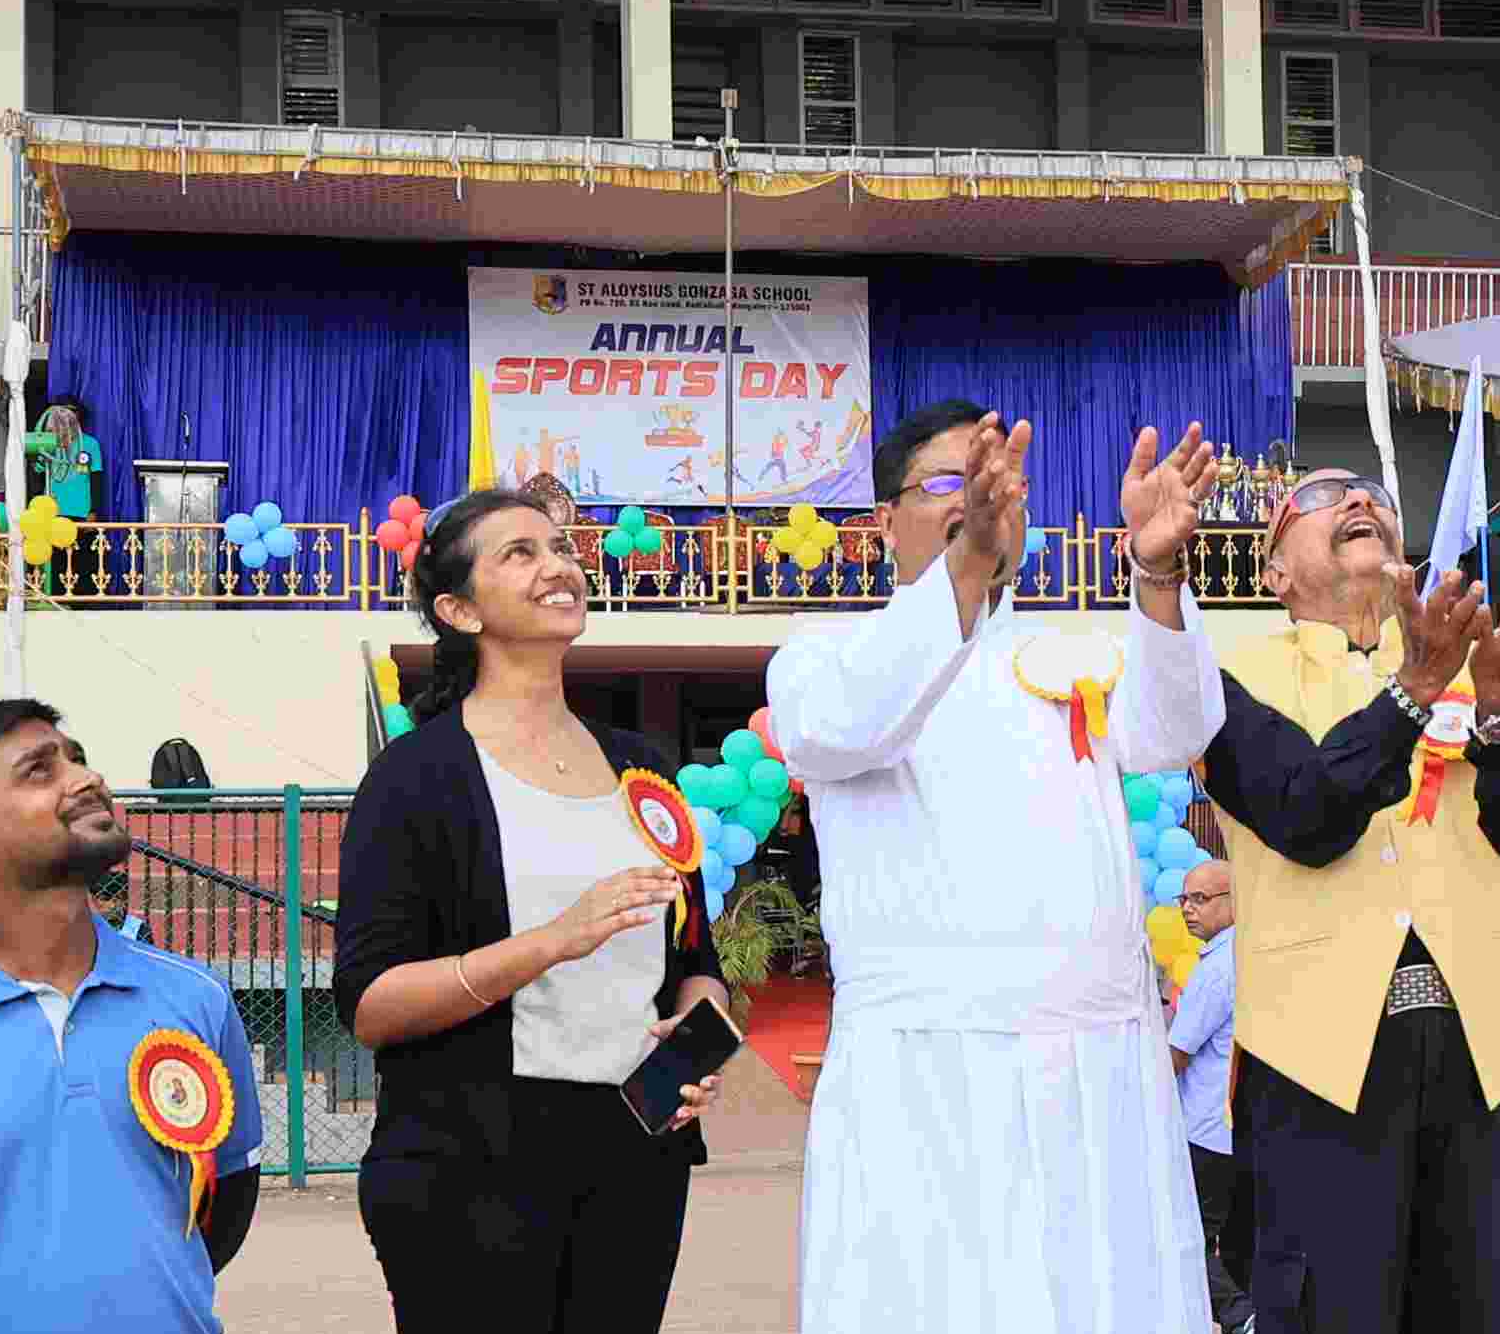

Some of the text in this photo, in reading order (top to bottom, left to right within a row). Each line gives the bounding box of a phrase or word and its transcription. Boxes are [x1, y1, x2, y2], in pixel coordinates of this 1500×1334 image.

[578, 282, 597, 296] ST
[601, 282, 673, 298] ALOYSIUS
[752, 287, 812, 301] SCHOOL
[589, 322, 755, 354] ANNUAL
[491, 357, 849, 399] SPORTS DAY
